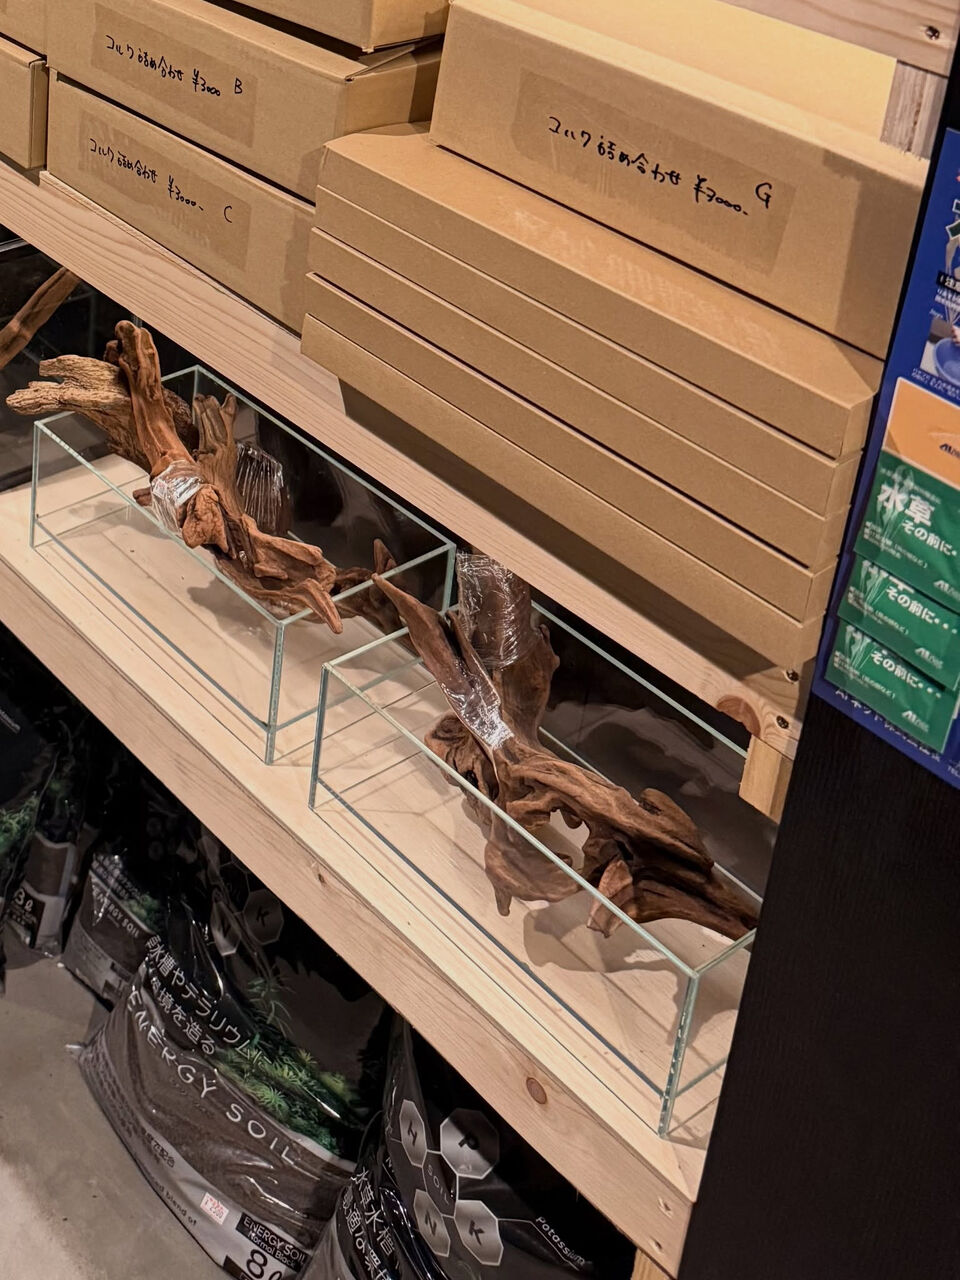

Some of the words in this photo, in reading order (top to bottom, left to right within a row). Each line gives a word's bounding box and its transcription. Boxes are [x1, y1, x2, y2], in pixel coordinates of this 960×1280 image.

[234, 77, 243, 95] B
[223, 204, 233, 224] C
[754, 181, 773, 210] G
[876, 483, 936, 527] 水草
[225, 1103, 295, 1166] SOIL
[427, 1164, 450, 1205] SOIL
[243, 1216, 285, 1250] ENERGY
[283, 1244, 306, 1265] SOIL
[247, 1230, 276, 1255] Normal
[275, 1250, 296, 1269] Black
[534, 1216, 586, 1266] Potassium
